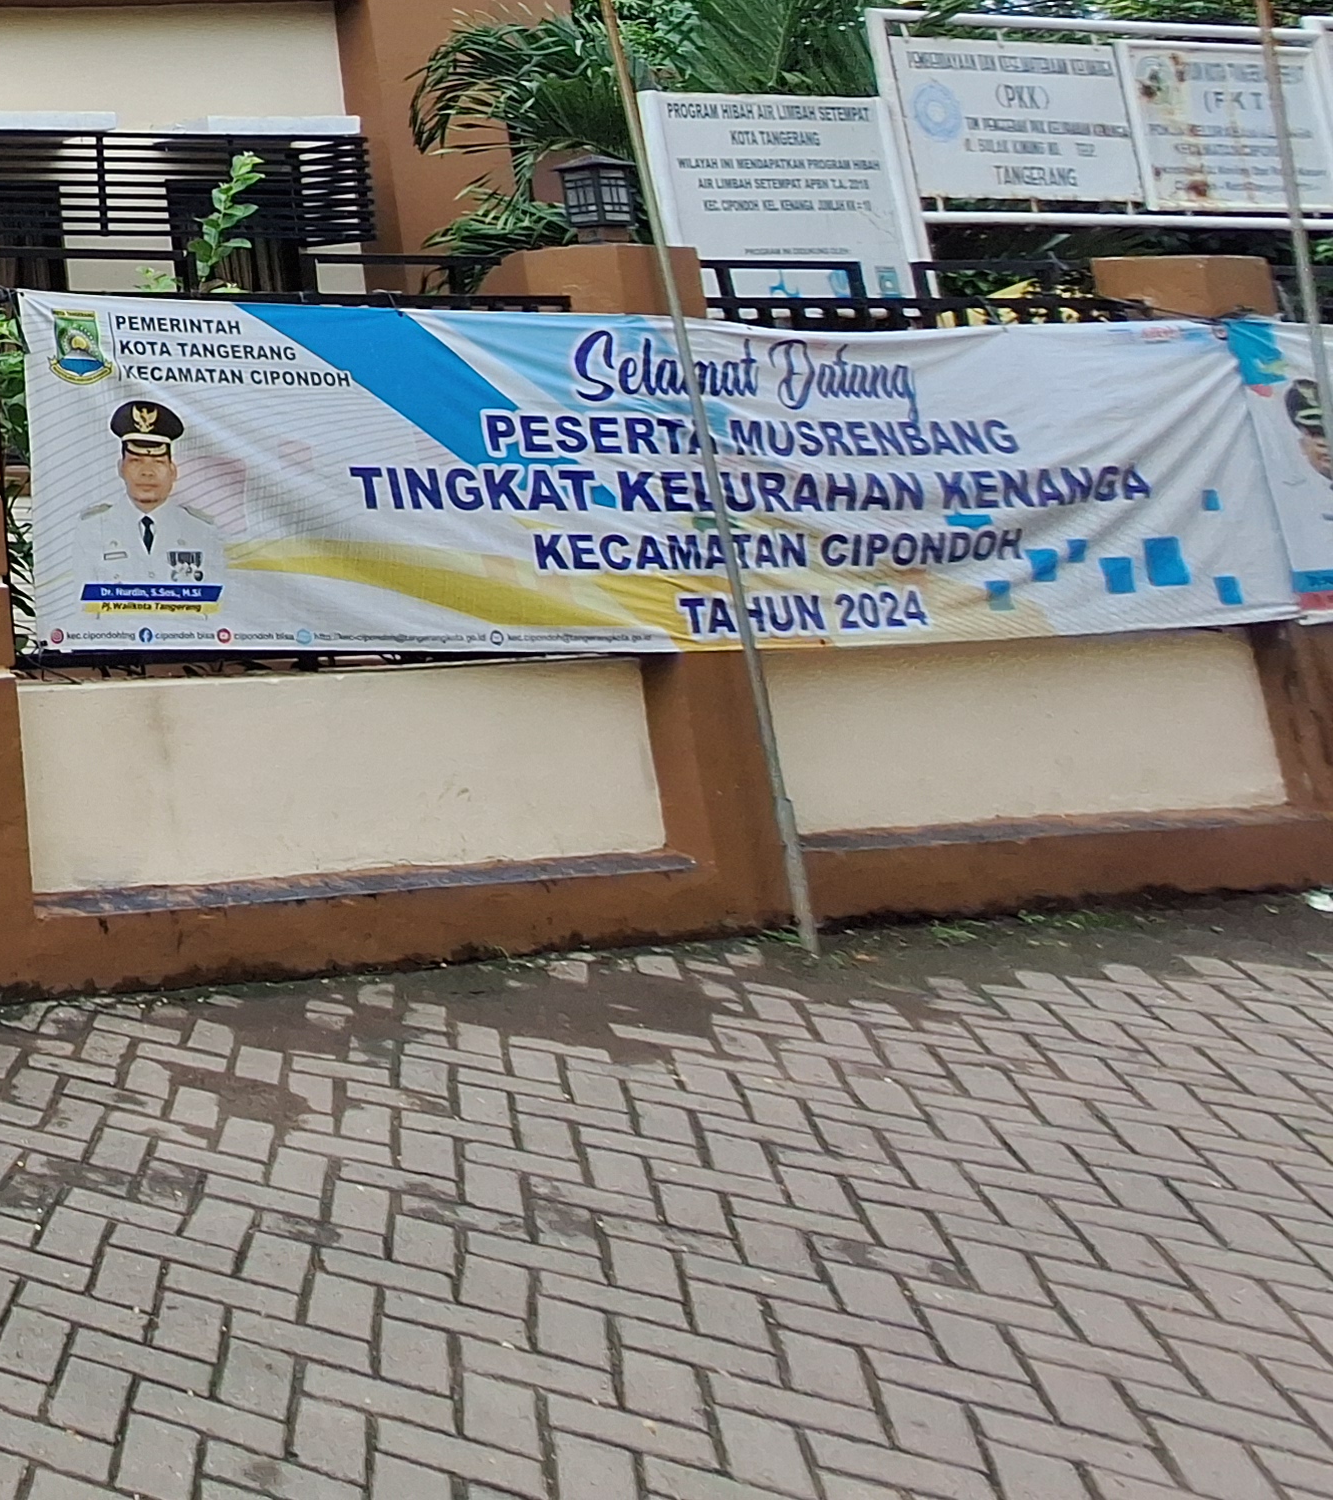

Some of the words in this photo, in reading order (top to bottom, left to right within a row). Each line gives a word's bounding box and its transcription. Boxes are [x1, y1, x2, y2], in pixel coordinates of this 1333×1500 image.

[995, 83, 1050, 110] (PKK)
[667, 103, 719, 119] PROGRAM
[721, 104, 755, 120] HIBAH
[757, 105, 776, 120] AIR
[778, 106, 816, 121] LIMBAH
[819, 107, 870, 122] SETEMPAT
[730, 130, 758, 146] KOTA
[759, 131, 821, 146] TANGERANG
[677, 157, 718, 169] WILAYAH
[720, 158, 734, 169] INI
[736, 158, 806, 170] MENDAPATKAN
[807, 159, 851, 170] PROGRAM
[853, 160, 881, 171] HIBAH
[698, 178, 715, 189] AIR
[717, 178, 752, 189] LIMBAH
[754, 178, 802, 190] SETEMPAT
[993, 165, 1079, 187] TANGERANG
[115, 315, 242, 335] PEMERINTAH
[119, 340, 172, 357] KOTA
[177, 343, 296, 361] TANGERANG
[122, 365, 244, 384] KECAMATAN
[251, 370, 351, 387] CIPONDOH
[574, 330, 760, 402] Selamat
[768, 338, 920, 424] Datang
[729, 418, 1020, 456] MUSRENBANG
[349, 466, 595, 512] TINGKAT
[617, 470, 925, 512] KELURAHAN
[934, 463, 1152, 510] KENANGA
[533, 533, 807, 570] KECAMATAN
[821, 528, 1024, 567] CIPONDOH
[100, 587, 113, 597] Dr.
[155, 602, 202, 612] Tangerang
[679, 594, 825, 634] TAHUN
[835, 589, 929, 629] 2024
[155, 631, 195, 642] cipondoh
[234, 632, 274, 642] cipondoh
